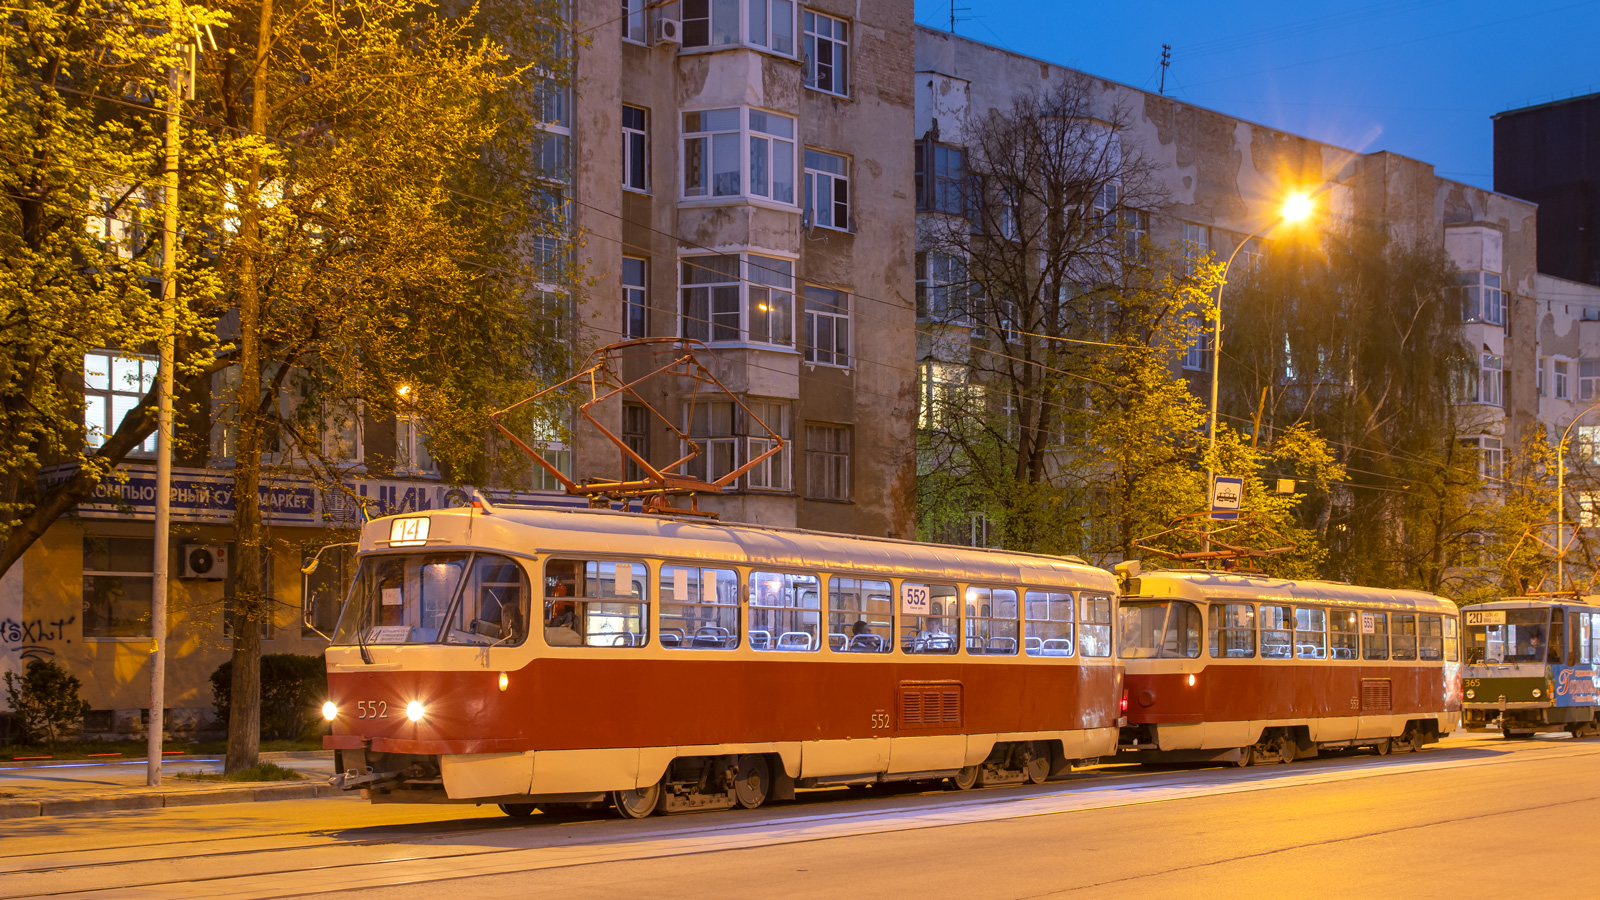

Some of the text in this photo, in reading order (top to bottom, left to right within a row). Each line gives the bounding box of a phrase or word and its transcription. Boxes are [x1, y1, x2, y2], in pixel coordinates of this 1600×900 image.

[90, 483, 210, 503] ОМПЬЮРНЫЙ
[215, 490, 308, 509] СУМАРКЕТ
[399, 519, 420, 544] 14
[907, 588, 926, 605] 552
[1469, 612, 1483, 624] 20
[366, 629, 382, 643] 14
[1465, 679, 1481, 687] 365
[357, 700, 388, 719] 552
[871, 714, 890, 729] 552
